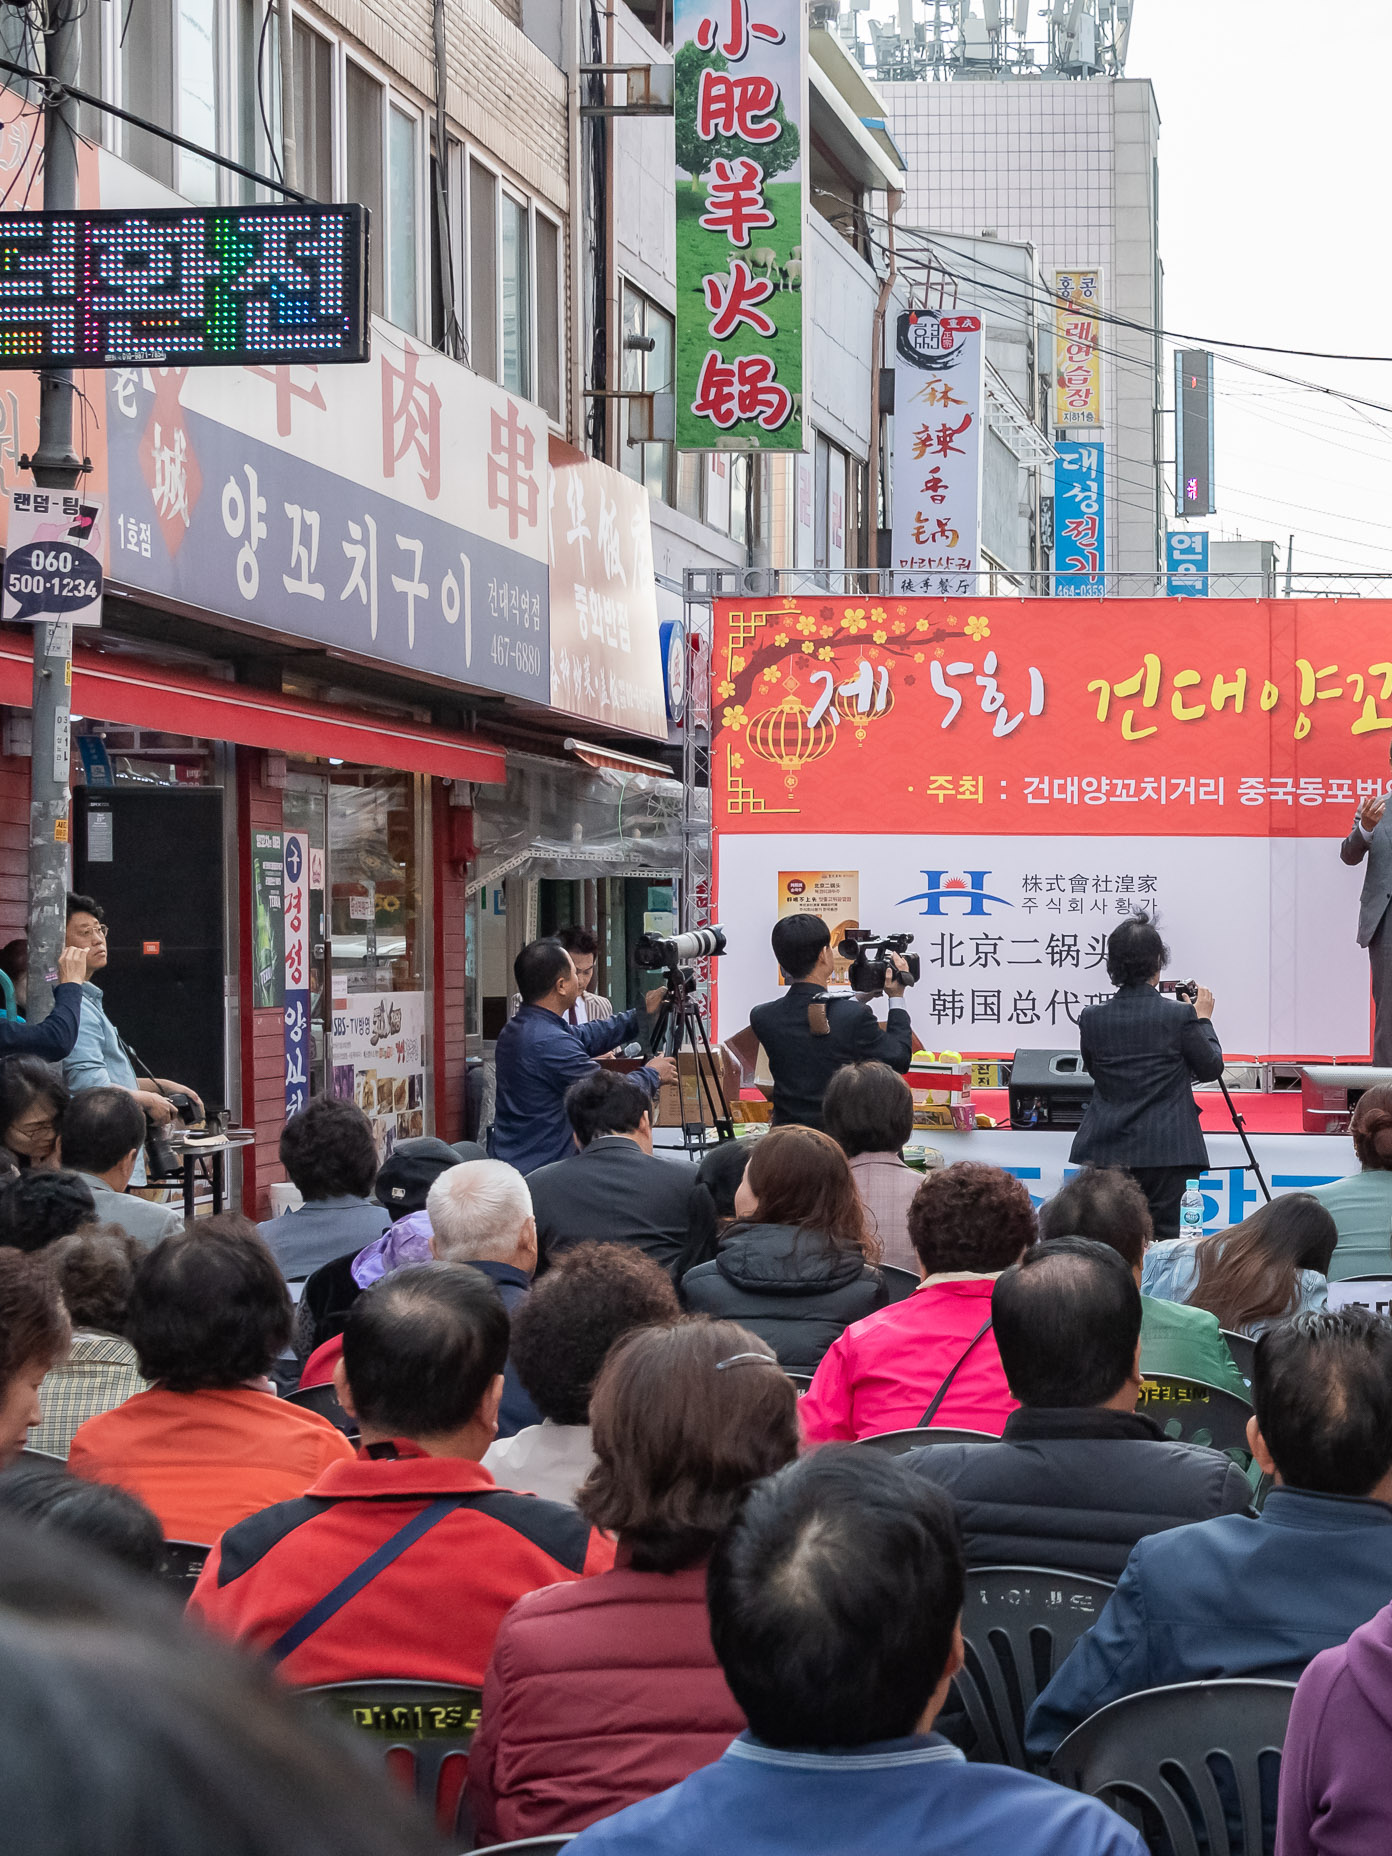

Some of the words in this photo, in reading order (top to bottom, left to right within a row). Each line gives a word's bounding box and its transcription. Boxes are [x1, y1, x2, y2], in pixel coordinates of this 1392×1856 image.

[691, 0, 791, 430] 小肥羊火锅
[1056, 276, 1097, 298] 홍콩
[1062, 411, 1095, 423] 지하1층
[907, 373, 973, 548] 麻辣香锅
[13, 493, 79, 516] 랜덤-팅
[117, 513, 152, 559] 1호점
[220, 463, 473, 668] 양꼬치구이
[487, 577, 541, 632] 건대직영점
[1057, 583, 1104, 598] 464-0353
[574, 582, 633, 654] 중화반점
[490, 634, 542, 678] 467-6880
[807, 661, 889, 730] 제
[929, 650, 1045, 739] 5회
[925, 776, 985, 804] 주최
[1022, 775, 1225, 806] 건대양꼬치거리
[283, 886, 304, 985] 경성
[929, 931, 1110, 970] 北京二锅头
